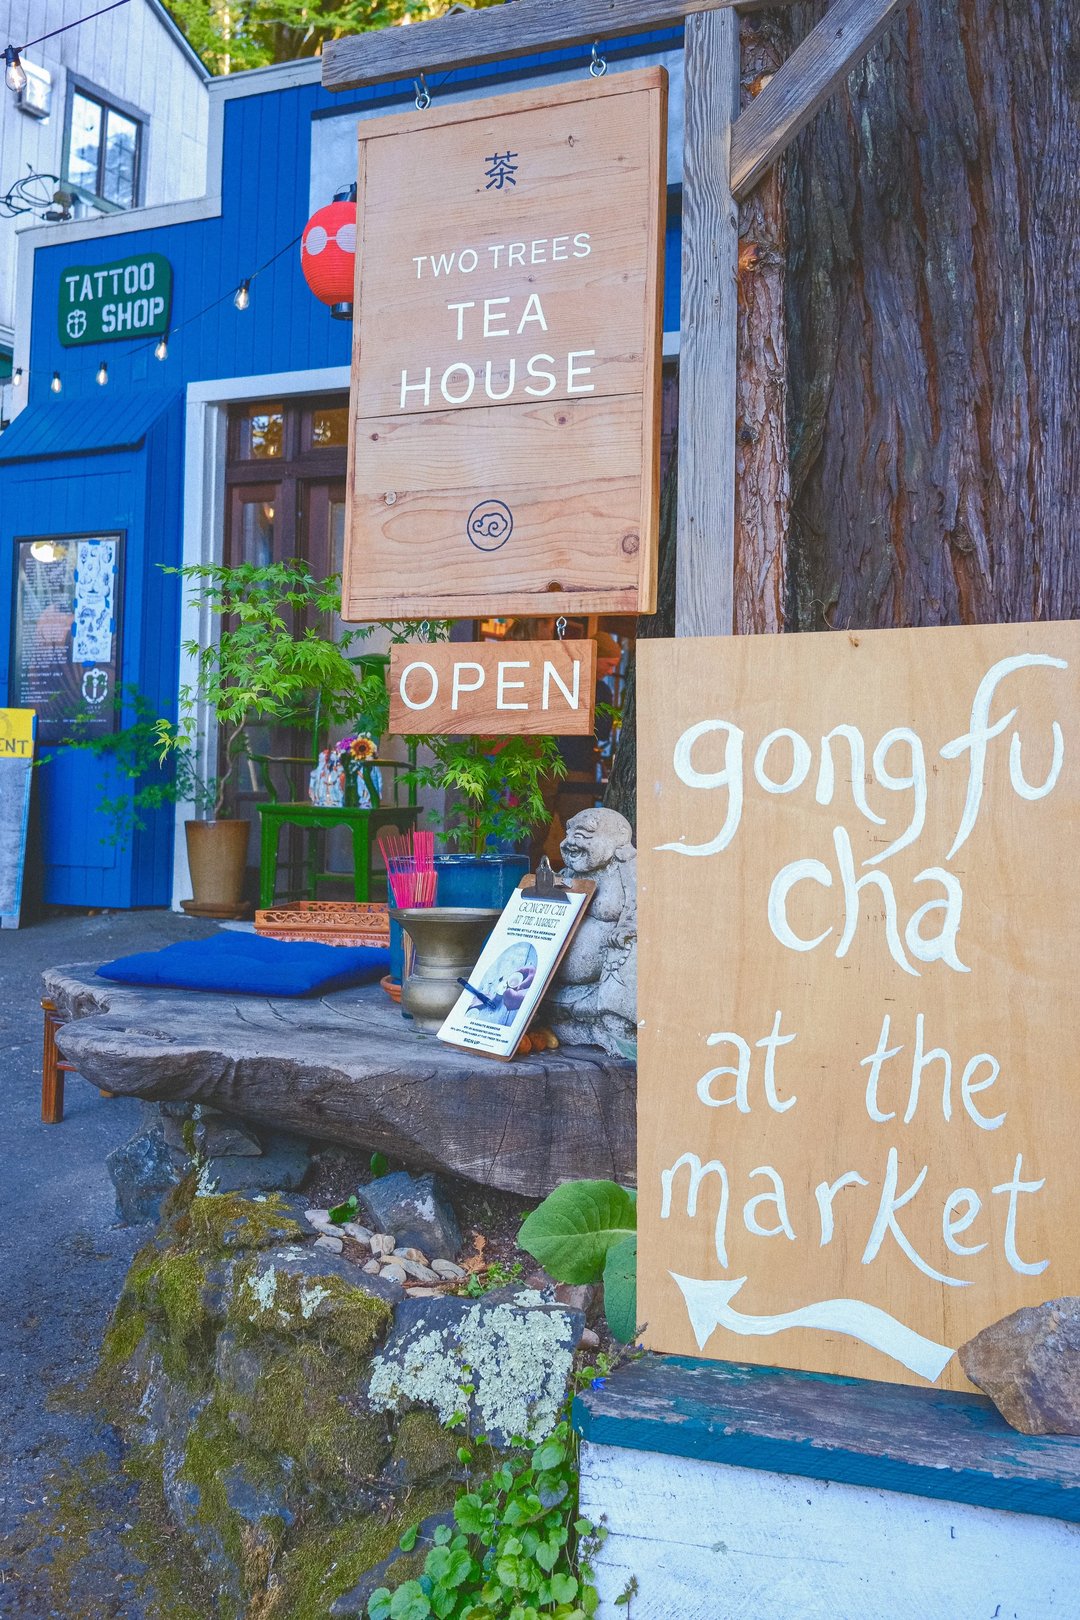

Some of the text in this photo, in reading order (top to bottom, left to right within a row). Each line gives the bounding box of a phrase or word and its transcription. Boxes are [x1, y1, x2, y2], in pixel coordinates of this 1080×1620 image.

[485, 151, 518, 190] 茶
[413, 233, 592, 280] TWO TREES
[65, 261, 155, 303] TATTOO
[102, 296, 165, 333] SHOP
[448, 293, 548, 340] TEA
[400, 349, 597, 409] HOUSE
[400, 660, 580, 711] OPEN
[768, 826, 972, 977] cha
[696, 1010, 1007, 1131] at the
[661, 1147, 1050, 1287] market
